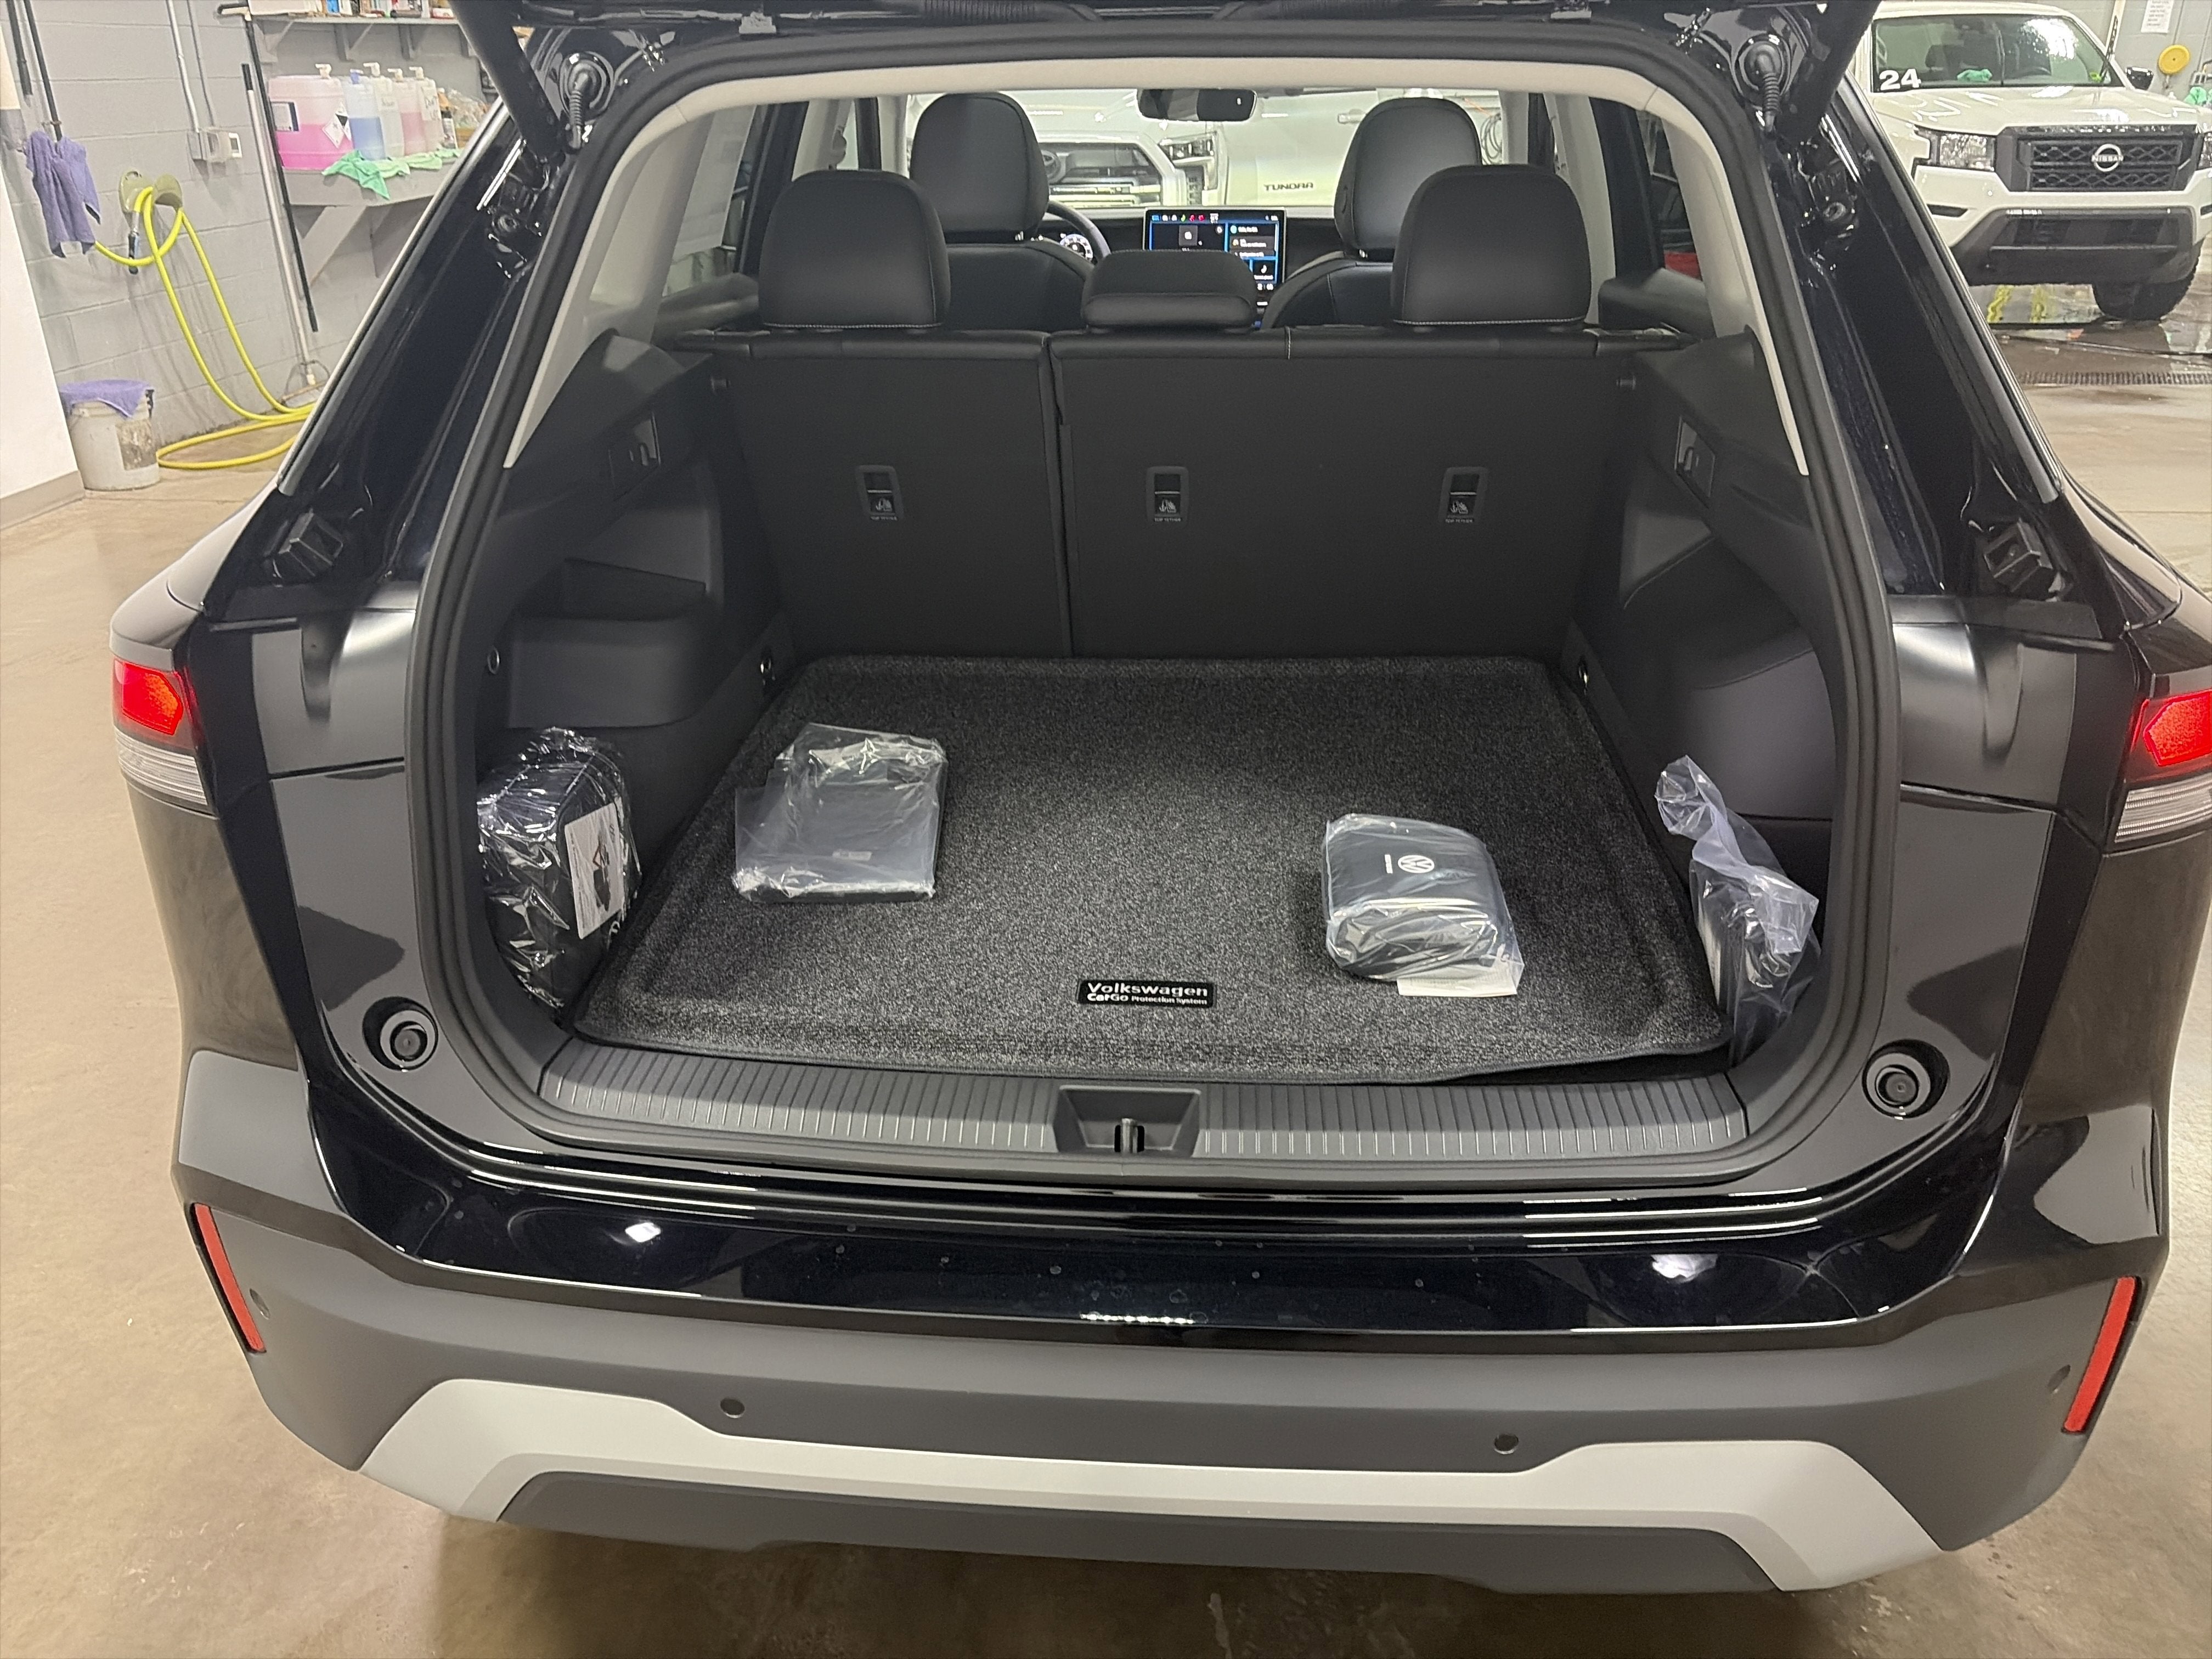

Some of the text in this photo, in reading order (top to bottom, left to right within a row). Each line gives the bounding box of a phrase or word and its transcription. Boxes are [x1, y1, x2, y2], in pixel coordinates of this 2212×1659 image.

[1879, 68, 1922, 91] 24
[2091, 154, 2124, 162] NISSAN
[1263, 182, 1314, 191] TUNDRA
[1087, 982, 1207, 997] Volkswagen
[1131, 995, 1175, 1004] Protection
